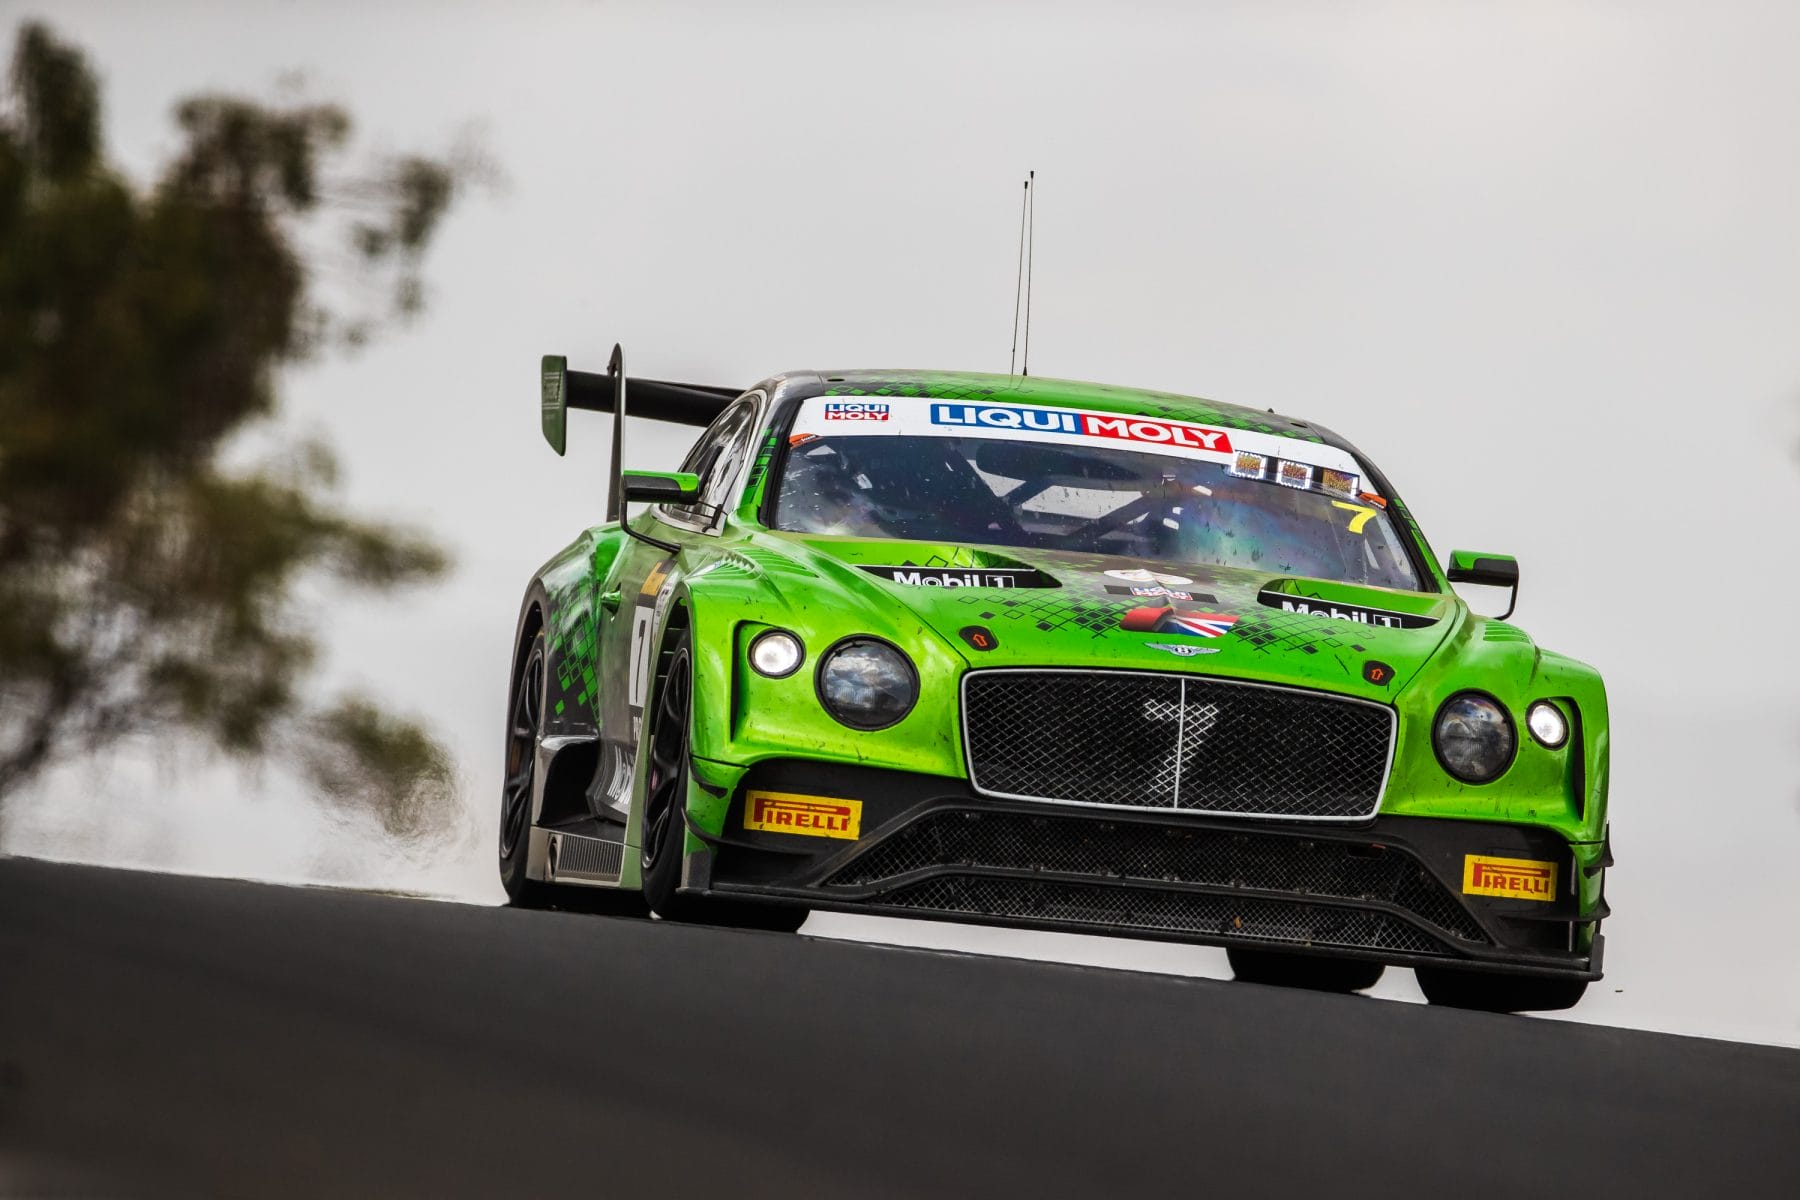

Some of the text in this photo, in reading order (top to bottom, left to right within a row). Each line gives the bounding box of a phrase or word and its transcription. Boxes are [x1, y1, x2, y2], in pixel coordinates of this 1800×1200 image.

[827, 411, 888, 420] MOLY
[828, 404, 887, 412] LIQUI
[938, 405, 1224, 450] LIQUI MOLY
[1331, 499, 1377, 535] 7
[893, 570, 980, 588] Mobil
[1143, 699, 1219, 796] 7
[753, 797, 851, 832] PIRELLI
[1472, 862, 1551, 894] PIRELLI
